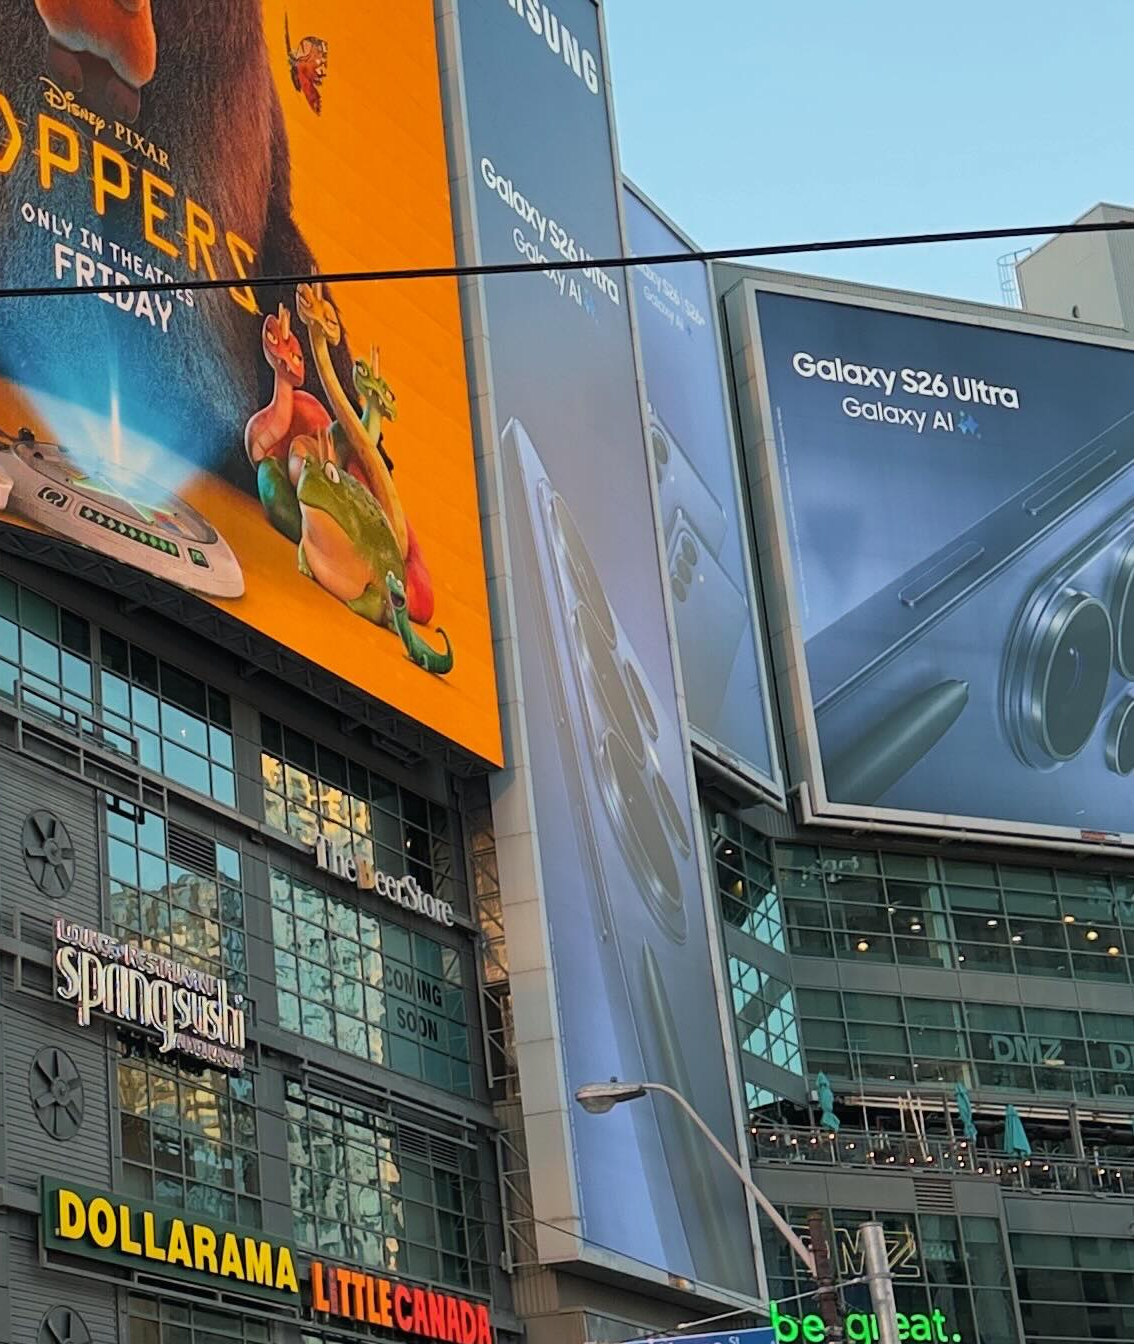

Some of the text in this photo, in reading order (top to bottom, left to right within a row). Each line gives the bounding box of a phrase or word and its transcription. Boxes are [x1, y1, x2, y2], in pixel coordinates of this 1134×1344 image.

[114, 121, 171, 171] PIXAR
[21, 202, 73, 240] ONLY
[80, 227, 103, 254] IN
[481, 157, 620, 305] Galaxy S26 Ultra
[53, 242, 174, 333] FRIDAY
[513, 228, 583, 306] Galaxy AI
[792, 351, 1021, 410] Galaxy S26 Ultra
[842, 396, 955, 434] Galaxy AI
[384, 964, 443, 1007] COMING
[396, 1007, 439, 1043] SOON
[992, 1034, 1062, 1065] DMZ
[57, 1187, 299, 1293] DOLLARAMA
[769, 1299, 826, 1343] be
